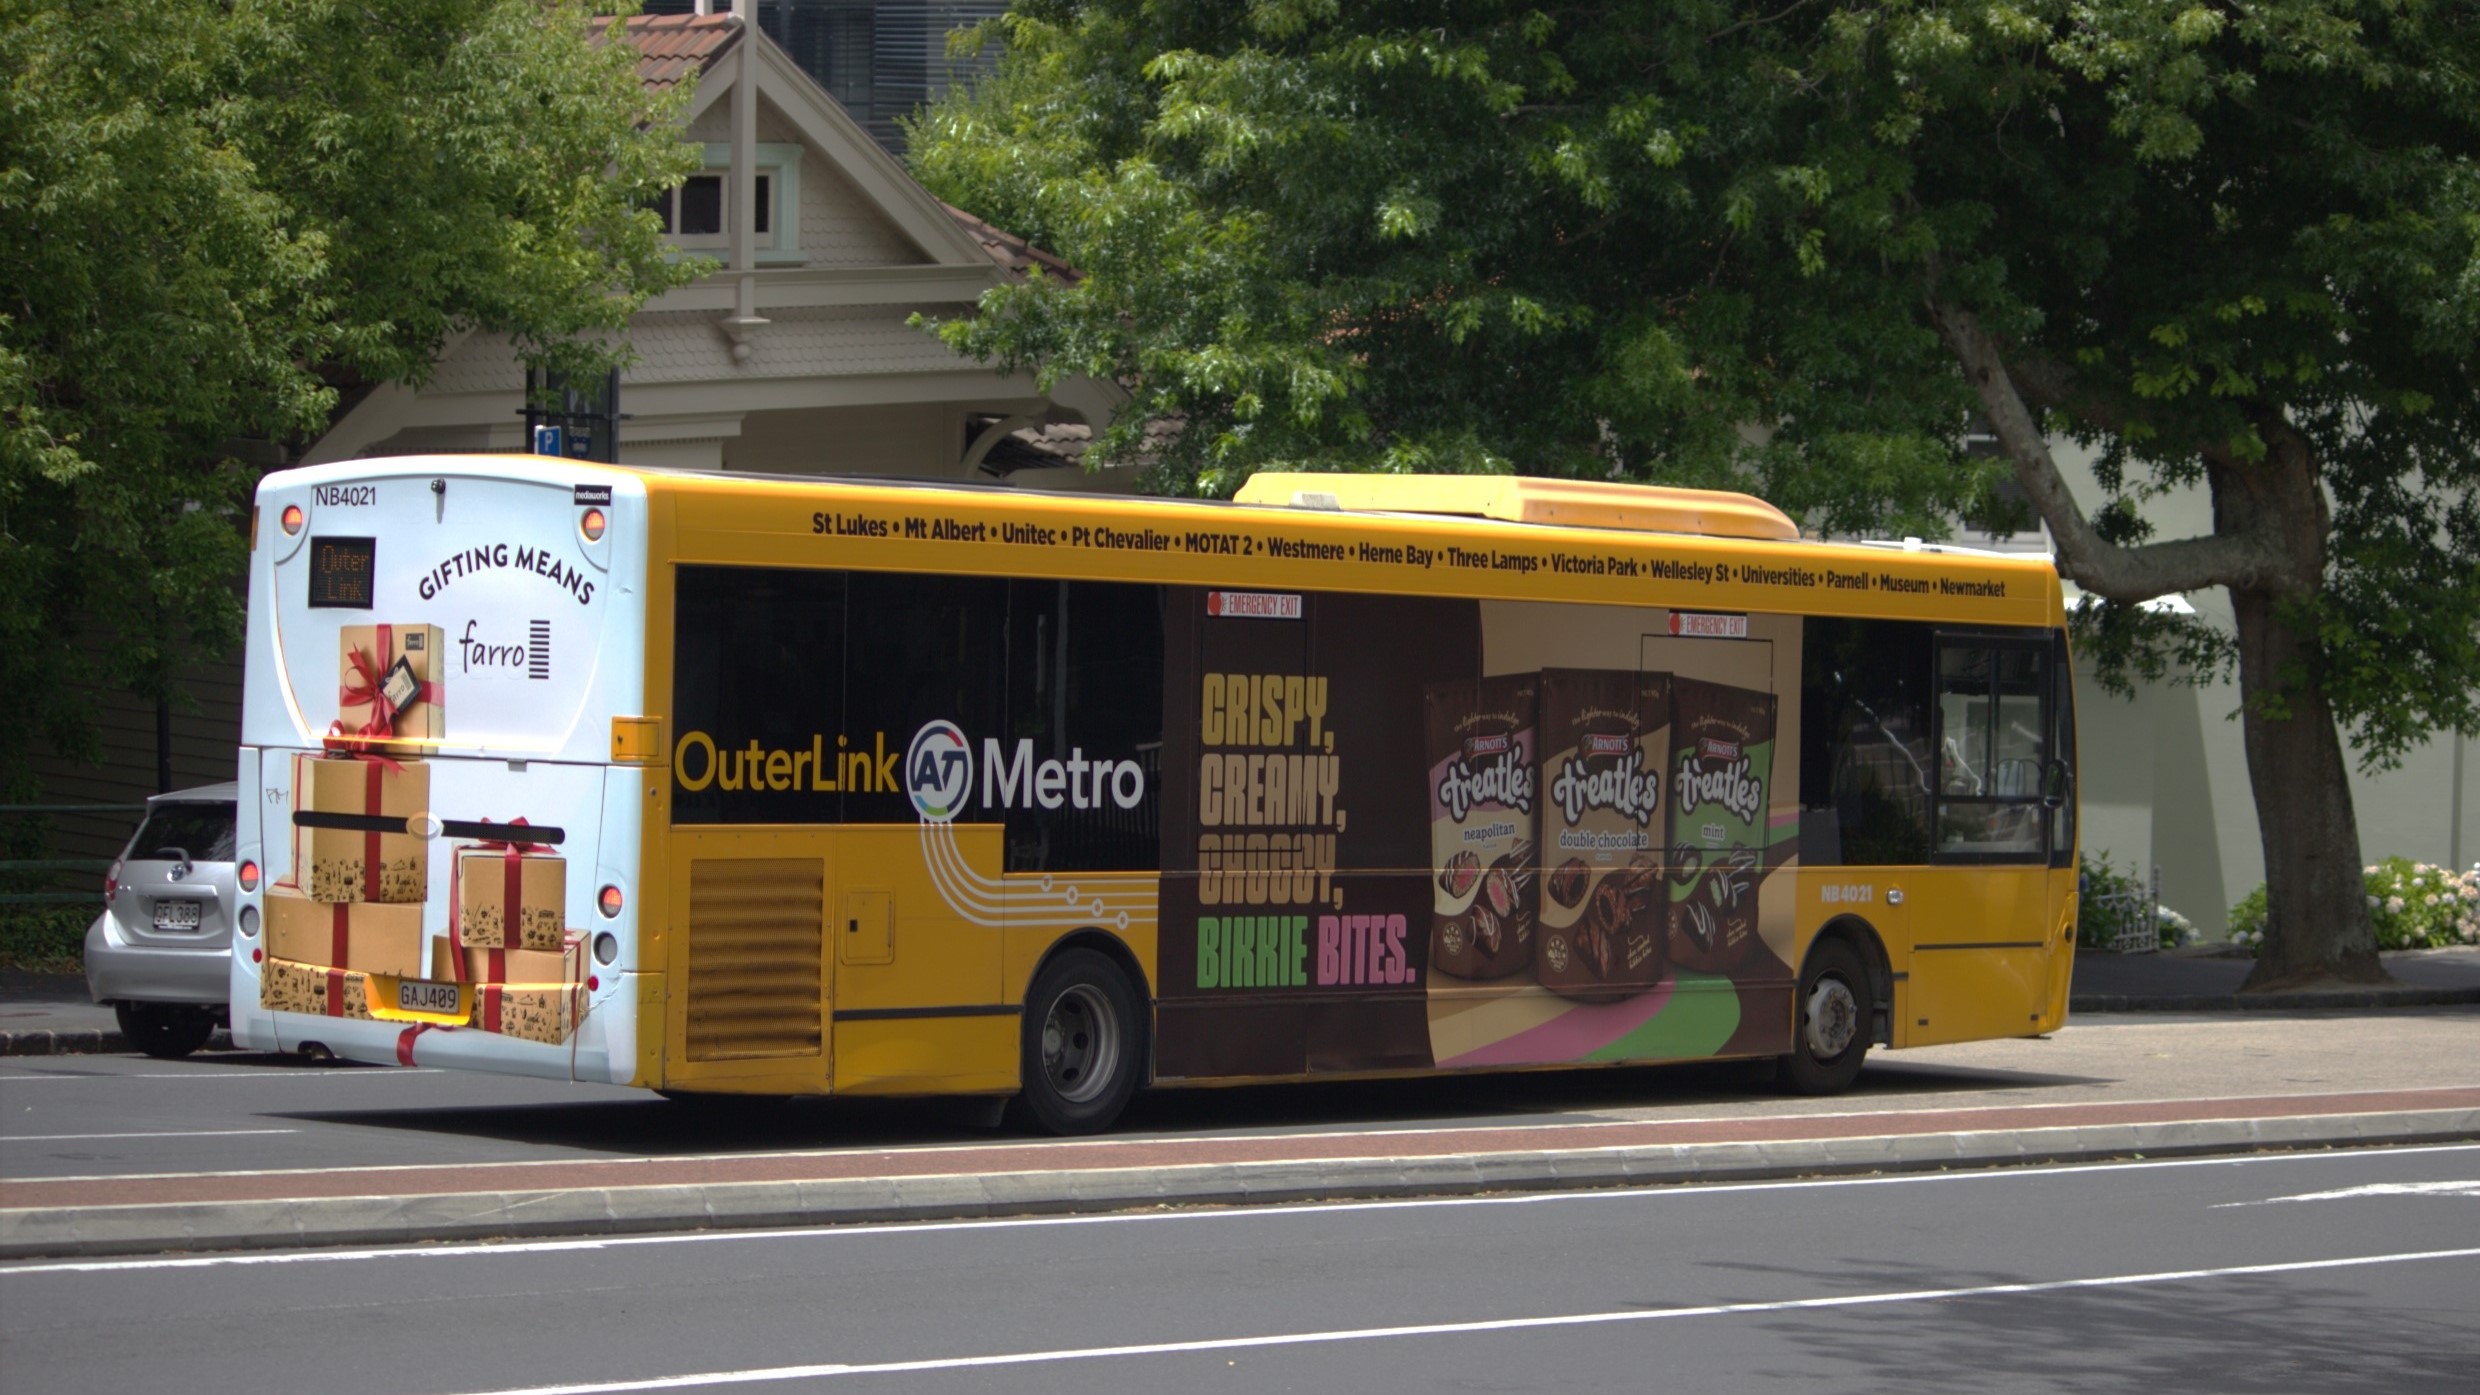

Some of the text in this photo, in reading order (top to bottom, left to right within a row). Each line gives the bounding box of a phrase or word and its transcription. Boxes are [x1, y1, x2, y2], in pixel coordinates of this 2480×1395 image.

[545, 432, 553, 452] P
[316, 486, 377, 506] NB4021
[575, 491, 609, 500] mediaworks
[321, 544, 369, 573] Outer
[812, 512, 2006, 598] St Lukes Mt Albert Unitec Pt Chevalier MOTAT 2 Westmere Herne Bay Three Lamps Victoria Park Wellesley St Universities Parnell Museum Newmarket
[419, 543, 594, 605] GIFTING MEANS
[328, 577, 361, 600] Link
[1229, 594, 1298, 616] EMERGENCY EXIT
[1686, 615, 1745, 636] EMERGENCY EXIT
[459, 619, 525, 674] farro
[1201, 672, 1334, 755] CRISPY,
[675, 731, 1145, 810] OuterLink AT Metro
[1440, 745, 1534, 820] treatles
[1199, 753, 1346, 833] CREAMY,
[1553, 751, 1657, 823] treatles
[1675, 757, 1760, 823] treatles
[1464, 823, 1515, 842] neapolitan
[1560, 832, 1648, 848] double chocolate
[1703, 824, 1724, 839] mint
[1821, 884, 1874, 903] NB4021
[1196, 914, 1416, 988] BIKKIE BITES.
[401, 985, 456, 1009] GAJ409
